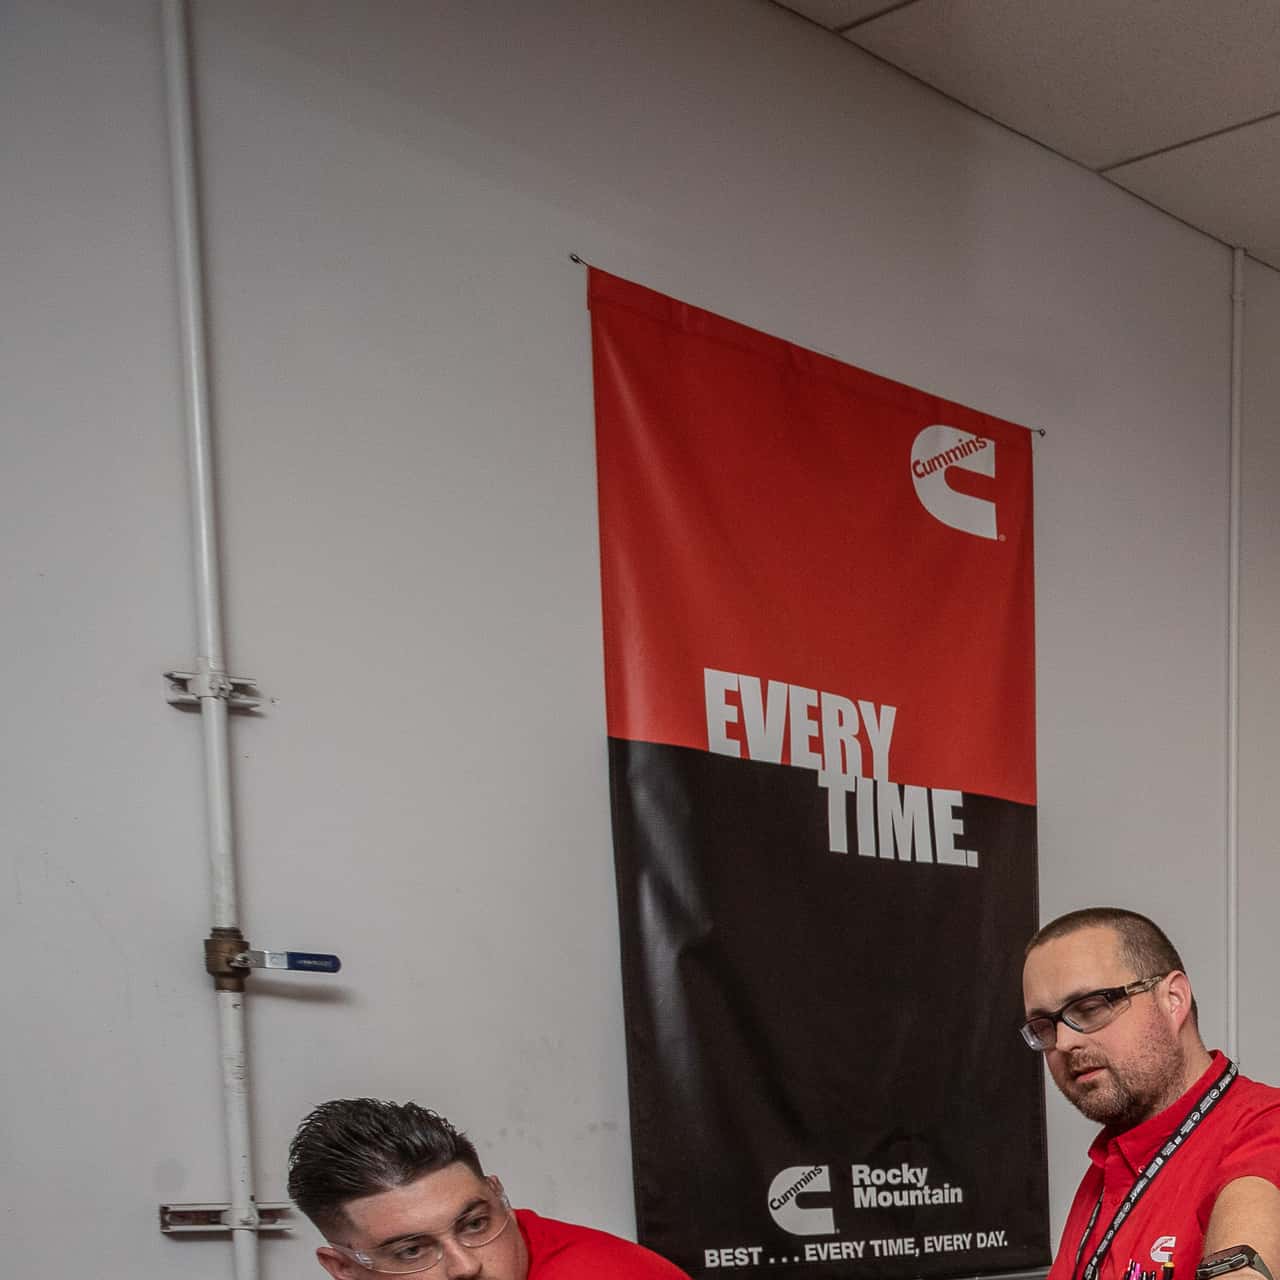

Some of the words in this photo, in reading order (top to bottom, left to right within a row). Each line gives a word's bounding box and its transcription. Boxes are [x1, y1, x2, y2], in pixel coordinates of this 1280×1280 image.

[912, 434, 988, 480] Cummins
[703, 667, 897, 784] EVERY
[817, 769, 979, 868] TIME.
[769, 1166, 823, 1211] Cummins
[851, 1163, 928, 1187] Rocky
[853, 1183, 963, 1208] Mountain
[804, 1240, 865, 1262] EVERY
[870, 1238, 920, 1257] TIME,
[924, 1233, 972, 1253] EVERY
[976, 1230, 1008, 1248] DAY.
